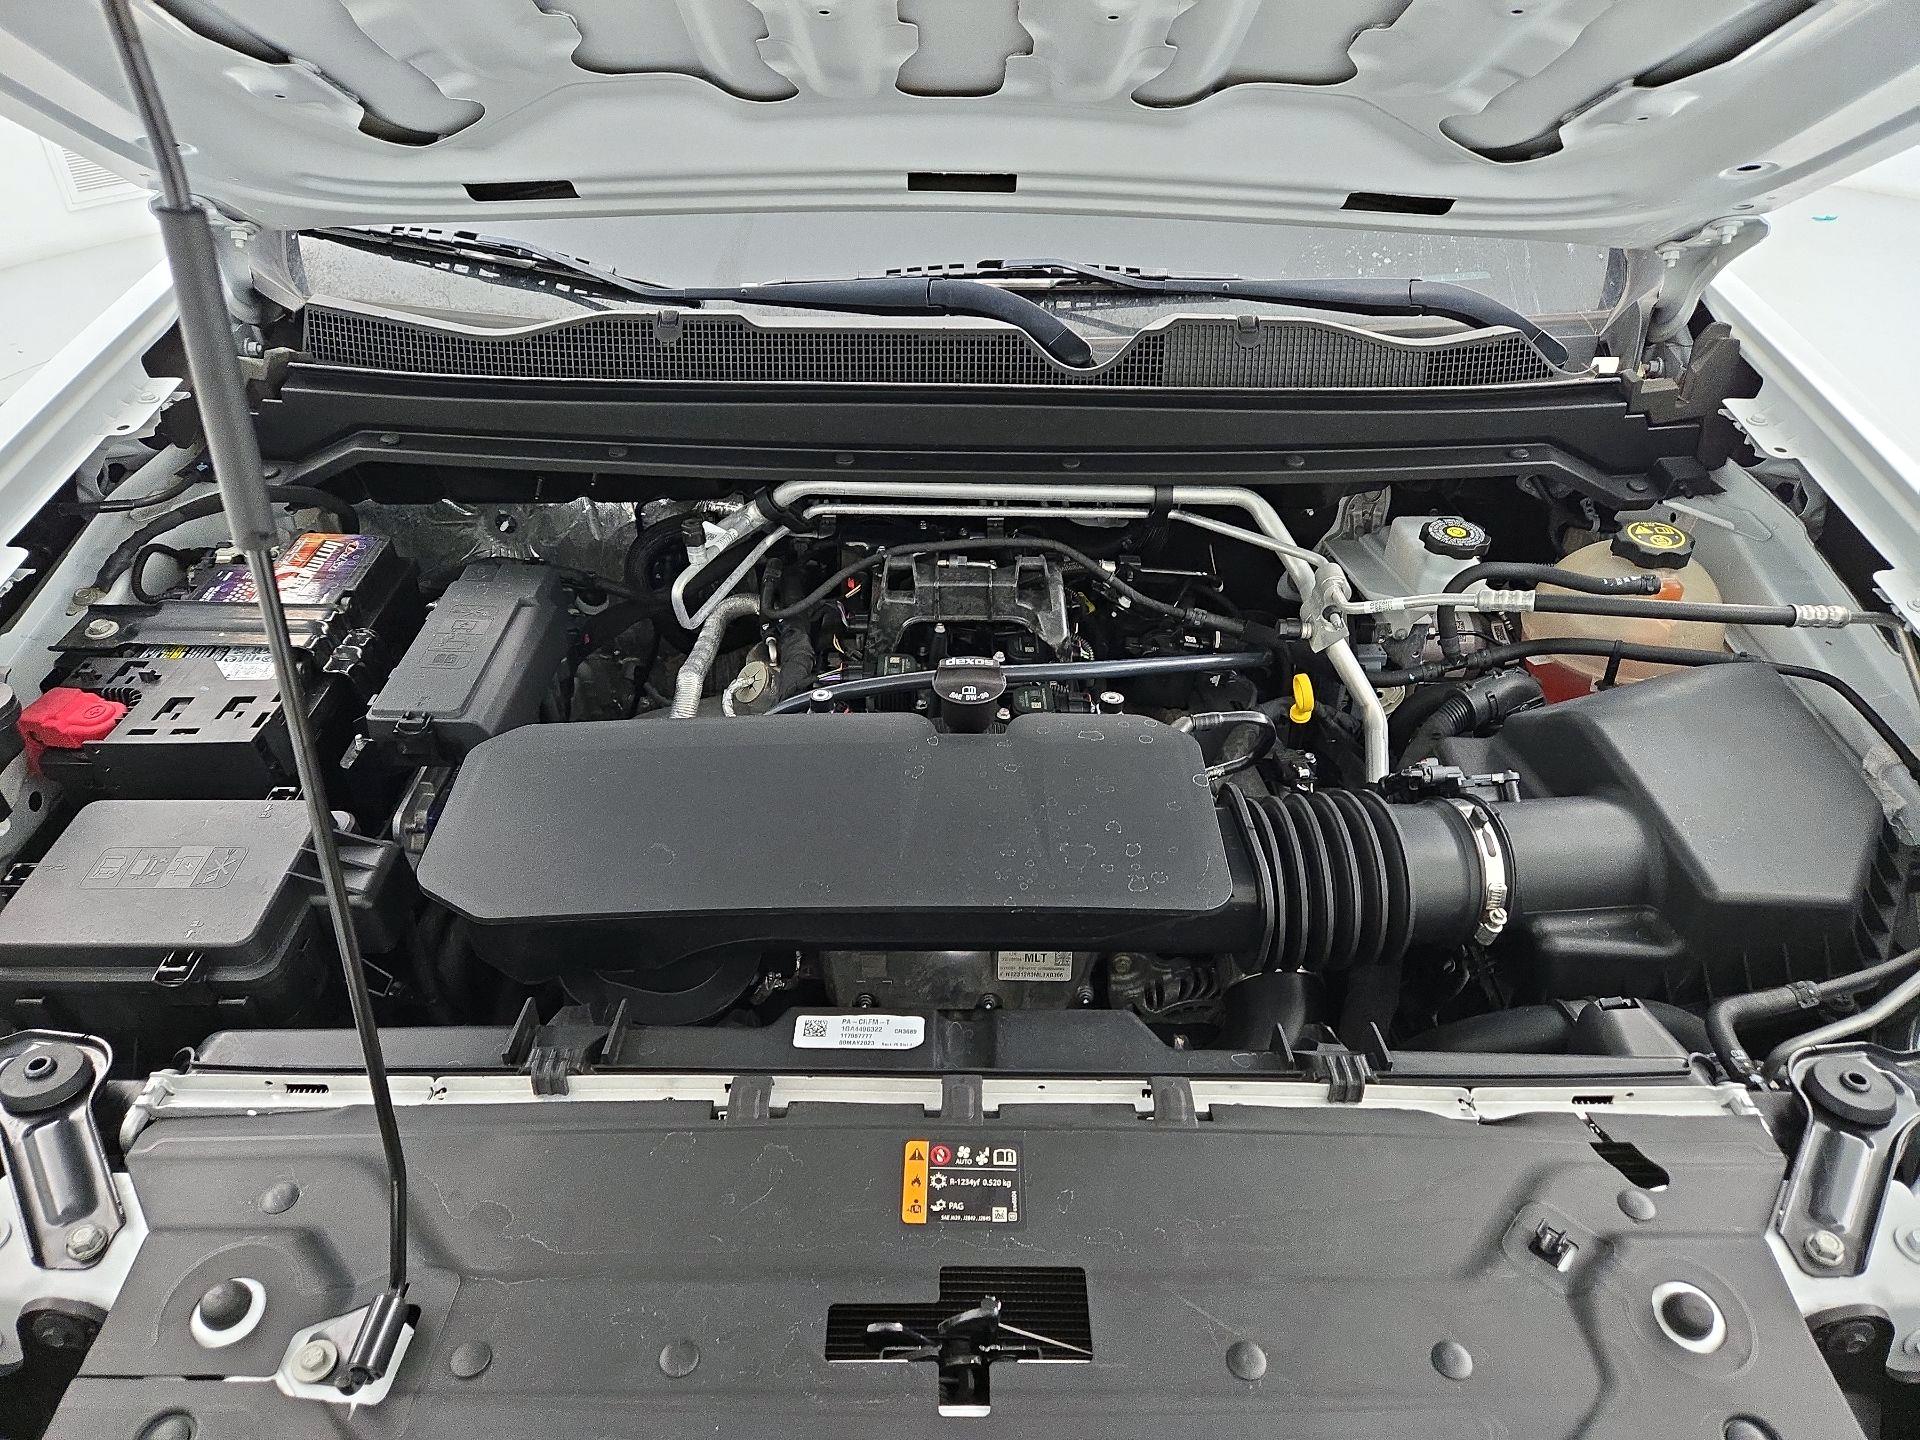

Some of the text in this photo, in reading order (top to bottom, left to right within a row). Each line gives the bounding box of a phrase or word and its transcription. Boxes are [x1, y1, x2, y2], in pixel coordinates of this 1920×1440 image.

[945, 657, 994, 666] dexos
[1024, 953, 1047, 963] MLT
[949, 1178, 1012, 1188] R-1234yf 0.520 kg
[948, 1202, 965, 1211] PAG
